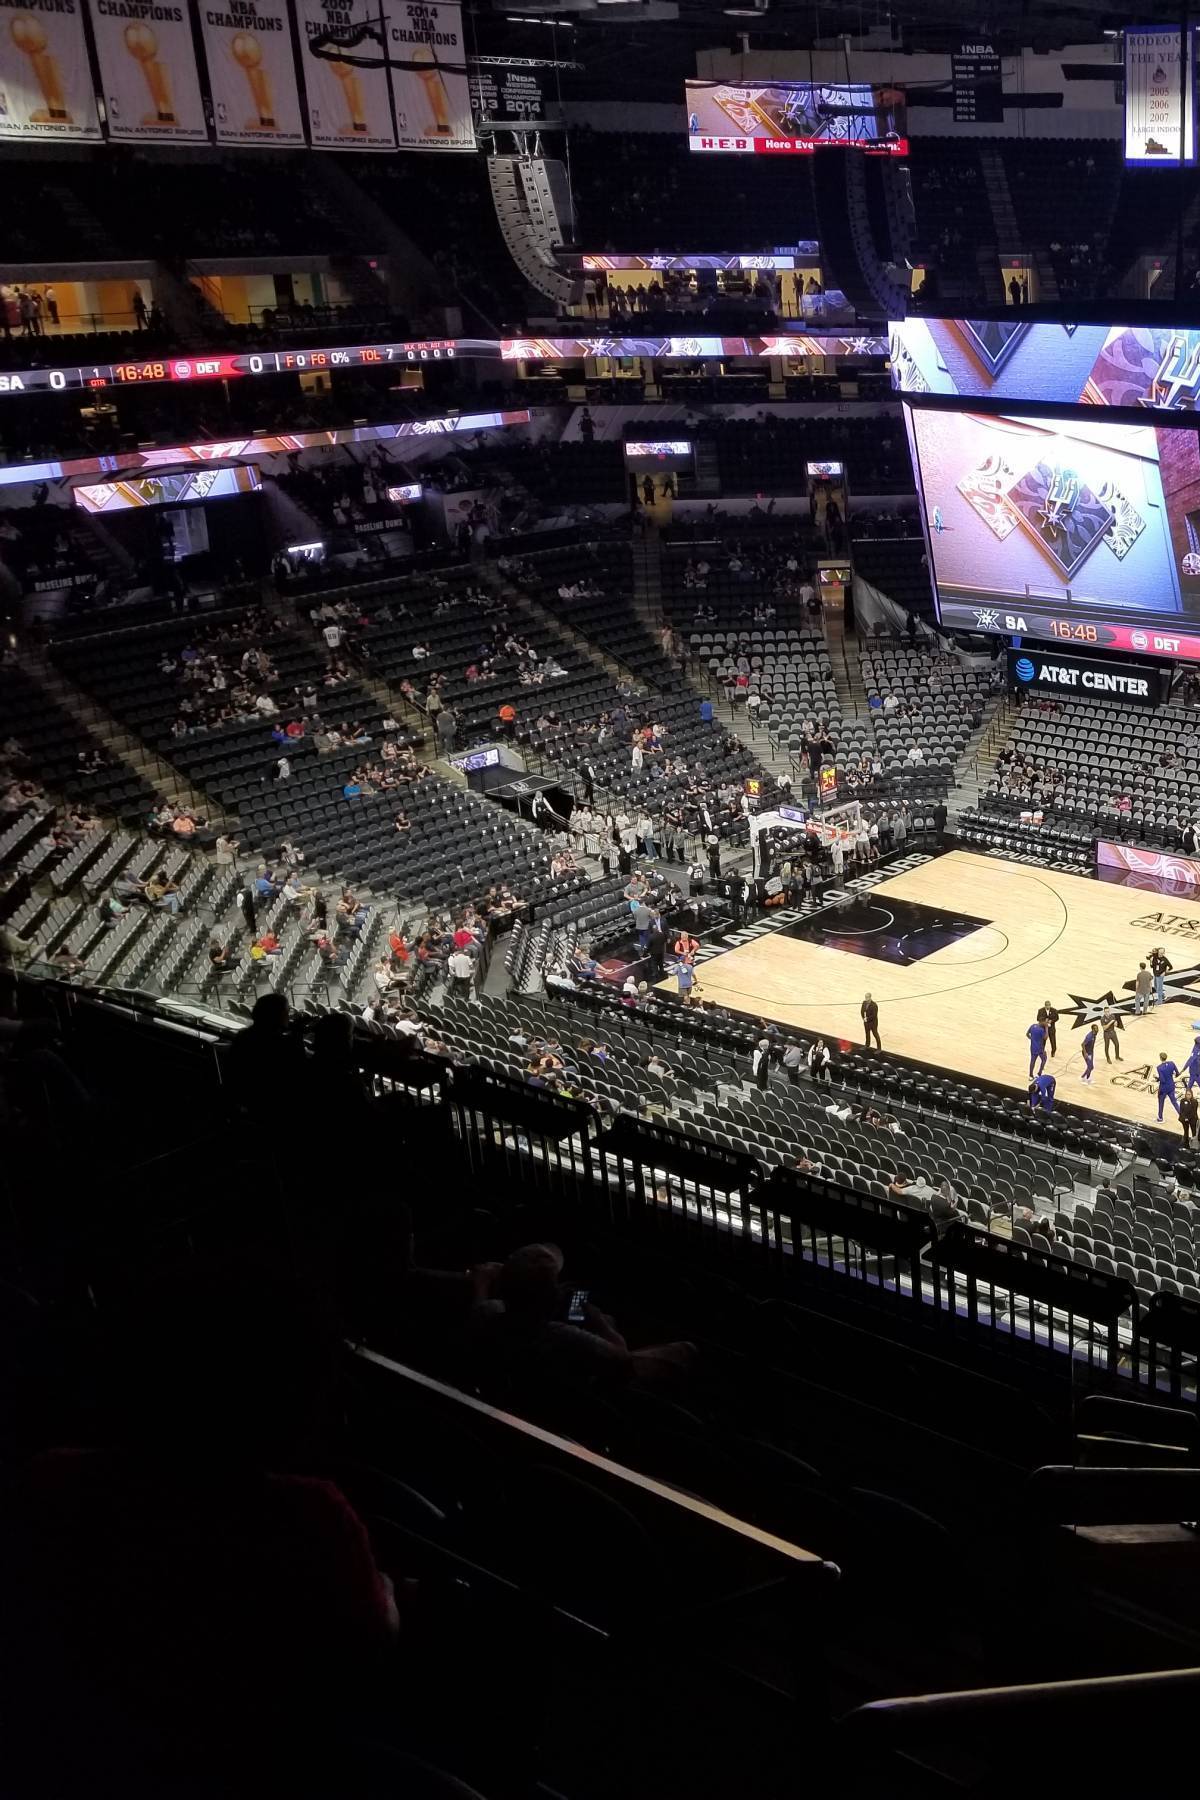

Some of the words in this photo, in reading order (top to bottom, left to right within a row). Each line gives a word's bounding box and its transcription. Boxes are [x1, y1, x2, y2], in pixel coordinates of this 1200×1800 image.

[98, 1, 183, 22] CHAMPIONS
[230, 0, 258, 16] NBA
[406, 5, 438, 19] 2014
[207, 11, 283, 31] CHAMPIONS
[327, 11, 351, 24] NBA
[412, 18, 436, 31] NBA
[392, 29, 458, 46] CHAMPIONS
[1129, 34, 1172, 46] RODEO
[1130, 53, 1156, 63] THE
[1150, 87, 1170, 96] 2005
[471, 98, 499, 109] 013
[506, 100, 541, 113] 2014
[1150, 100, 1169, 109] 2006
[1150, 113, 1169, 122] 2007
[765, 139, 791, 149] Here
[286, 356, 293, 368] F
[296, 355, 305, 367] 0
[311, 354, 326, 365] FG
[331, 351, 349, 363] 0%
[360, 350, 381, 361] TOL
[386, 349, 393, 360] 7
[407, 351, 414, 359] 0
[420, 350, 427, 358] 0
[434, 349, 440, 357] 0
[447, 348, 454, 356] 0
[92, 368, 99, 378] 1
[115, 363, 165, 381] 16:48
[196, 361, 221, 374] DET
[250, 357, 264, 373] 0
[49, 371, 66, 389] 0
[1005, 615, 1028, 632] SA
[1050, 620, 1097, 642] 16:48
[1154, 636, 1180, 652] DET
[1038, 664, 1080, 686] AT&T
[1082, 671, 1149, 697] CENTER
[985, 847, 1095, 875] SPURS.COM
[844, 852, 935, 892] SPURS
